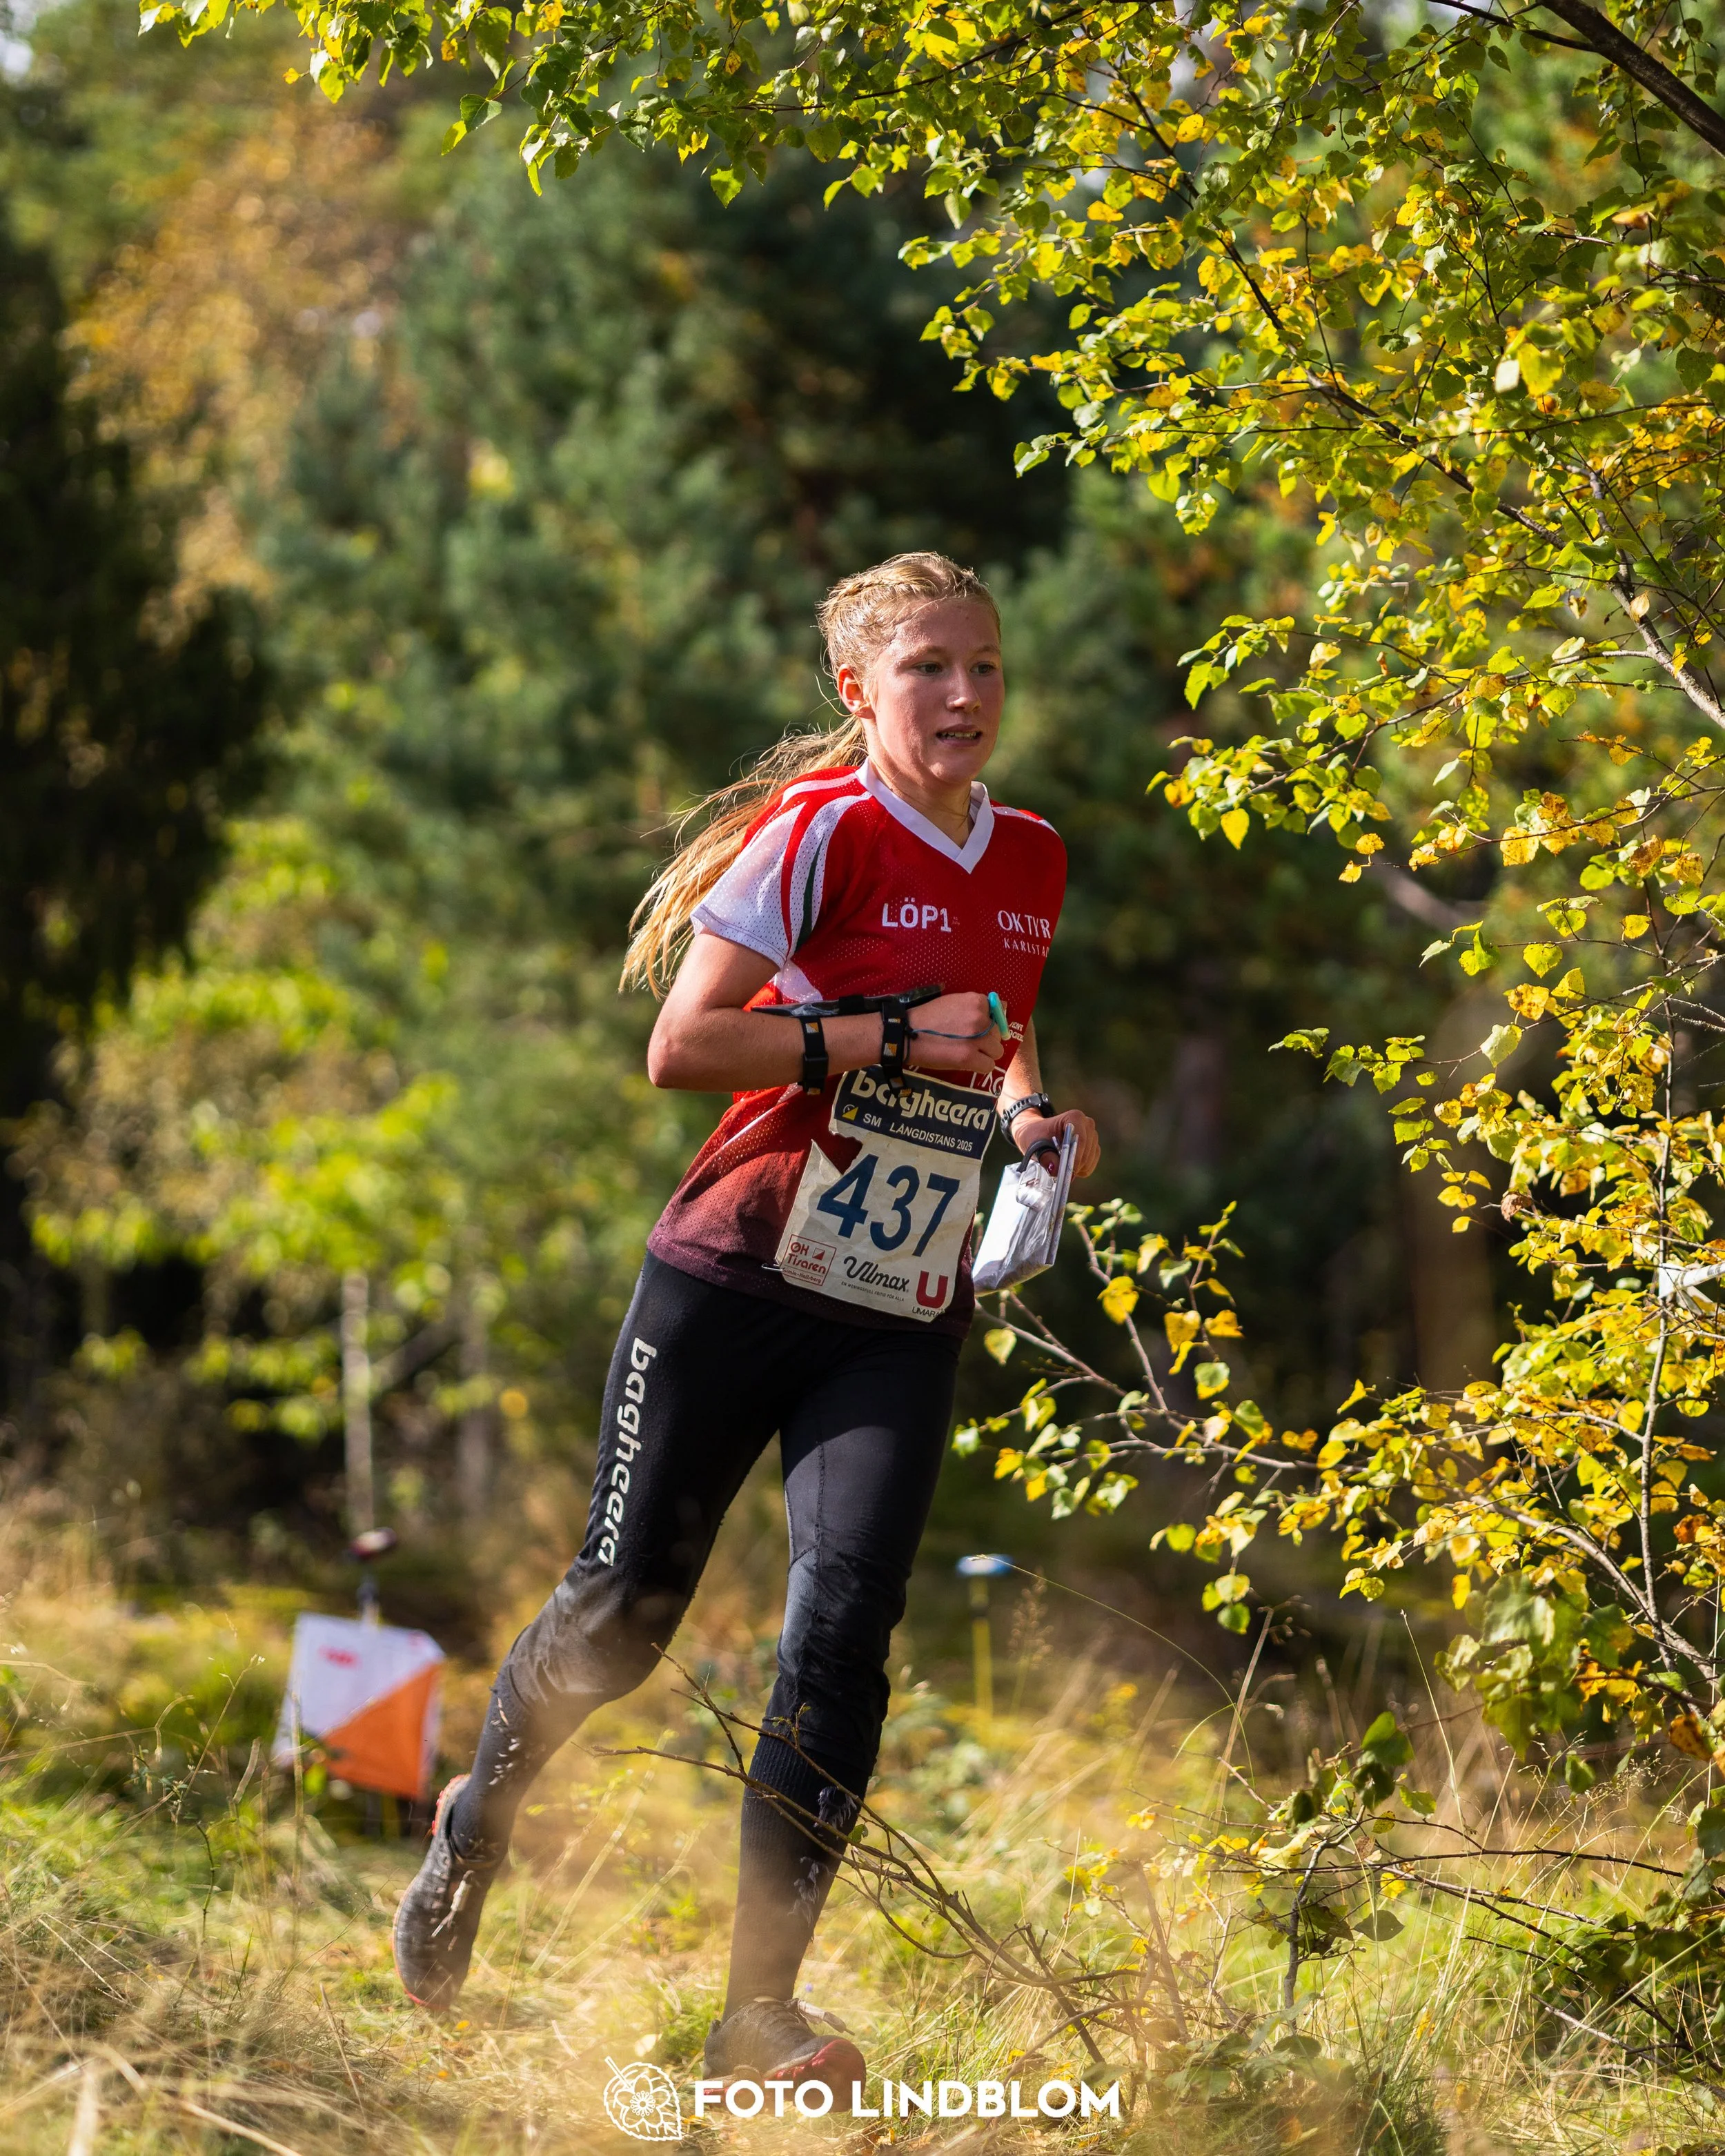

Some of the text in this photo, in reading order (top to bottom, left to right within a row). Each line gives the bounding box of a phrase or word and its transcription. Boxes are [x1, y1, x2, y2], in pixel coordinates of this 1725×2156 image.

[882, 897, 952, 933] LÖP1
[997, 910, 1051, 938] OK TYR
[862, 1113, 973, 1152] SM LÅNGDISTANS 2025
[817, 1154, 960, 1257] 437
[787, 1253, 827, 1274] Tisaren
[843, 1256, 909, 1292] Ullmax
[916, 1270, 949, 1309] U
[598, 1337, 657, 1566] bagheera
